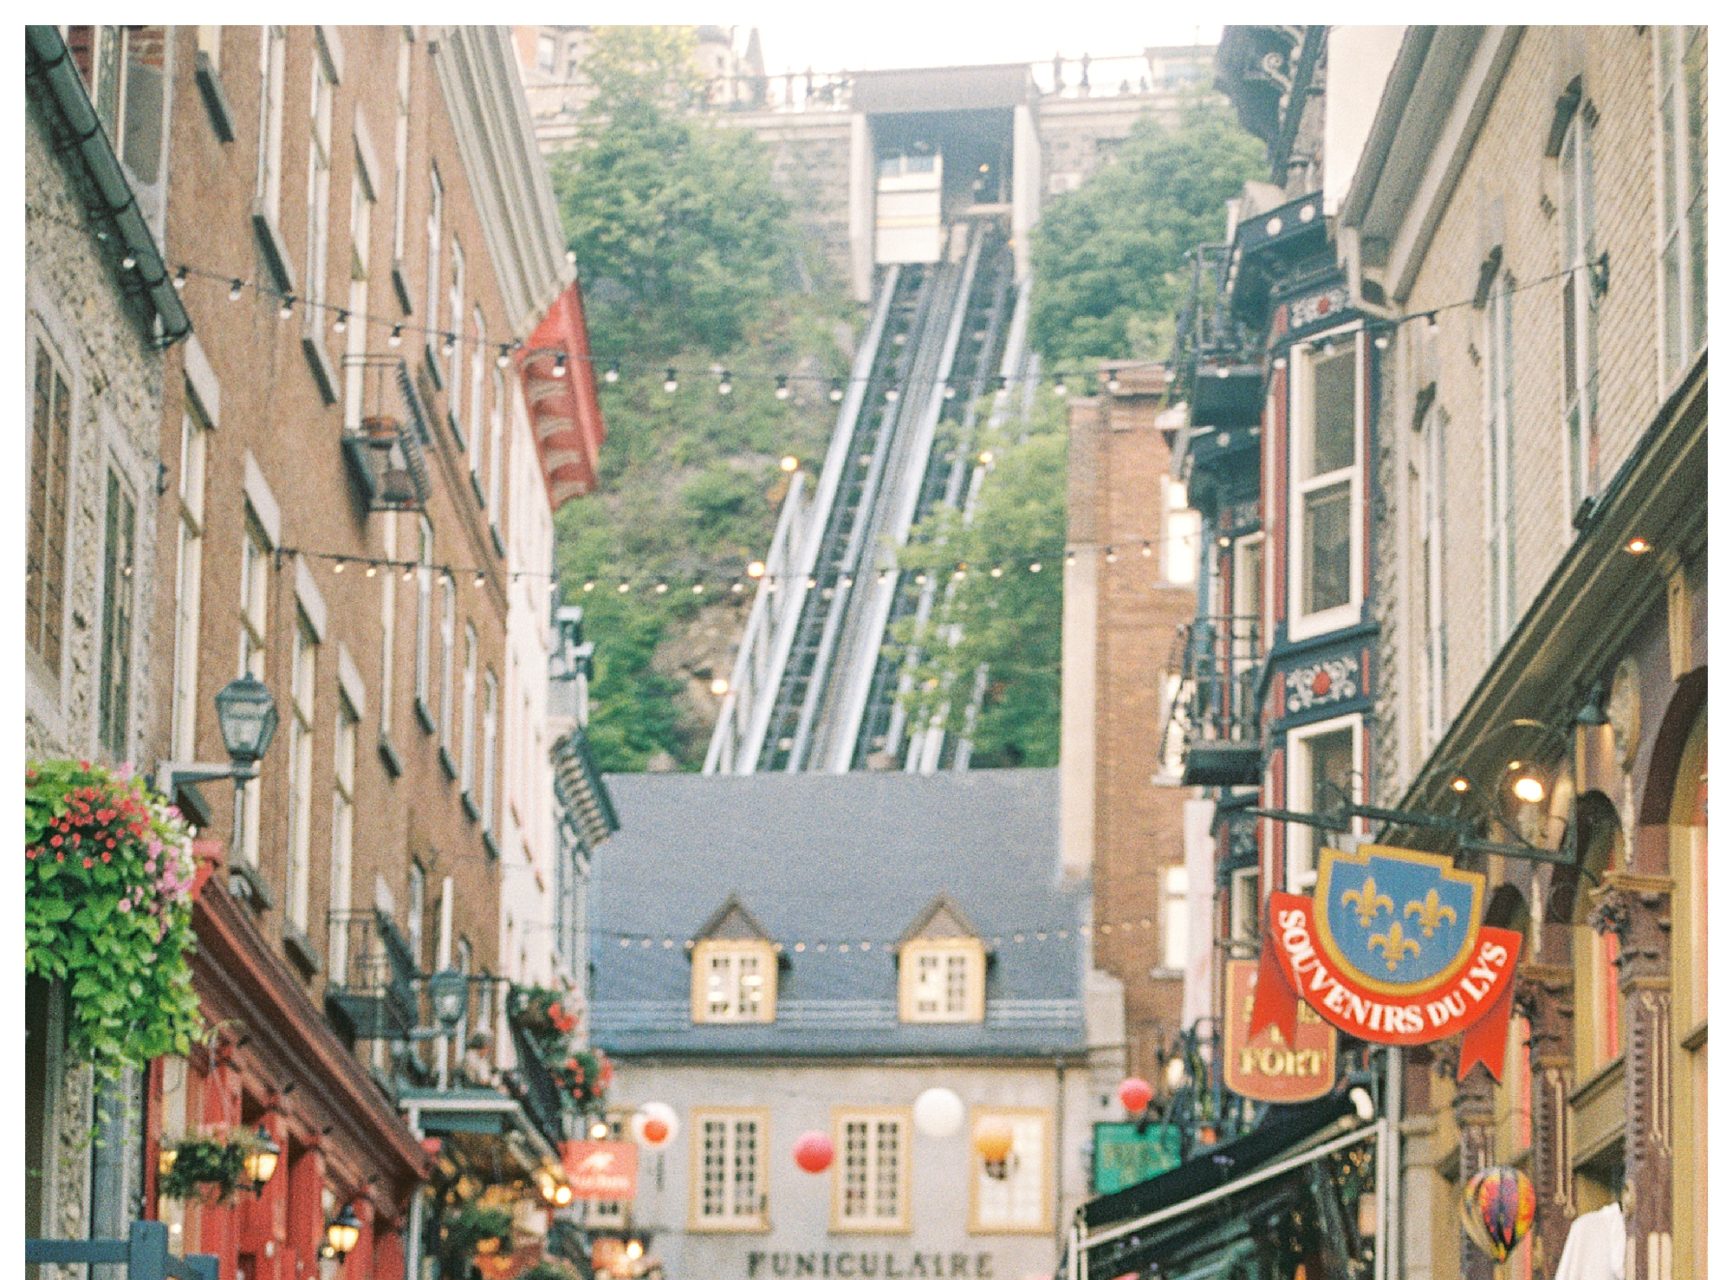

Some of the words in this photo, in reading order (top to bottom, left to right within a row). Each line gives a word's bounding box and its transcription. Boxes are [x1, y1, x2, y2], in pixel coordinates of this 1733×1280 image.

[1278, 909, 1424, 1034] SOUVENIRS
[1426, 991, 1466, 1027] DU
[1460, 941, 1507, 1002] LYS
[1240, 1048, 1325, 1076] FORT
[747, 1252, 993, 1279] FUNICULAIRE
